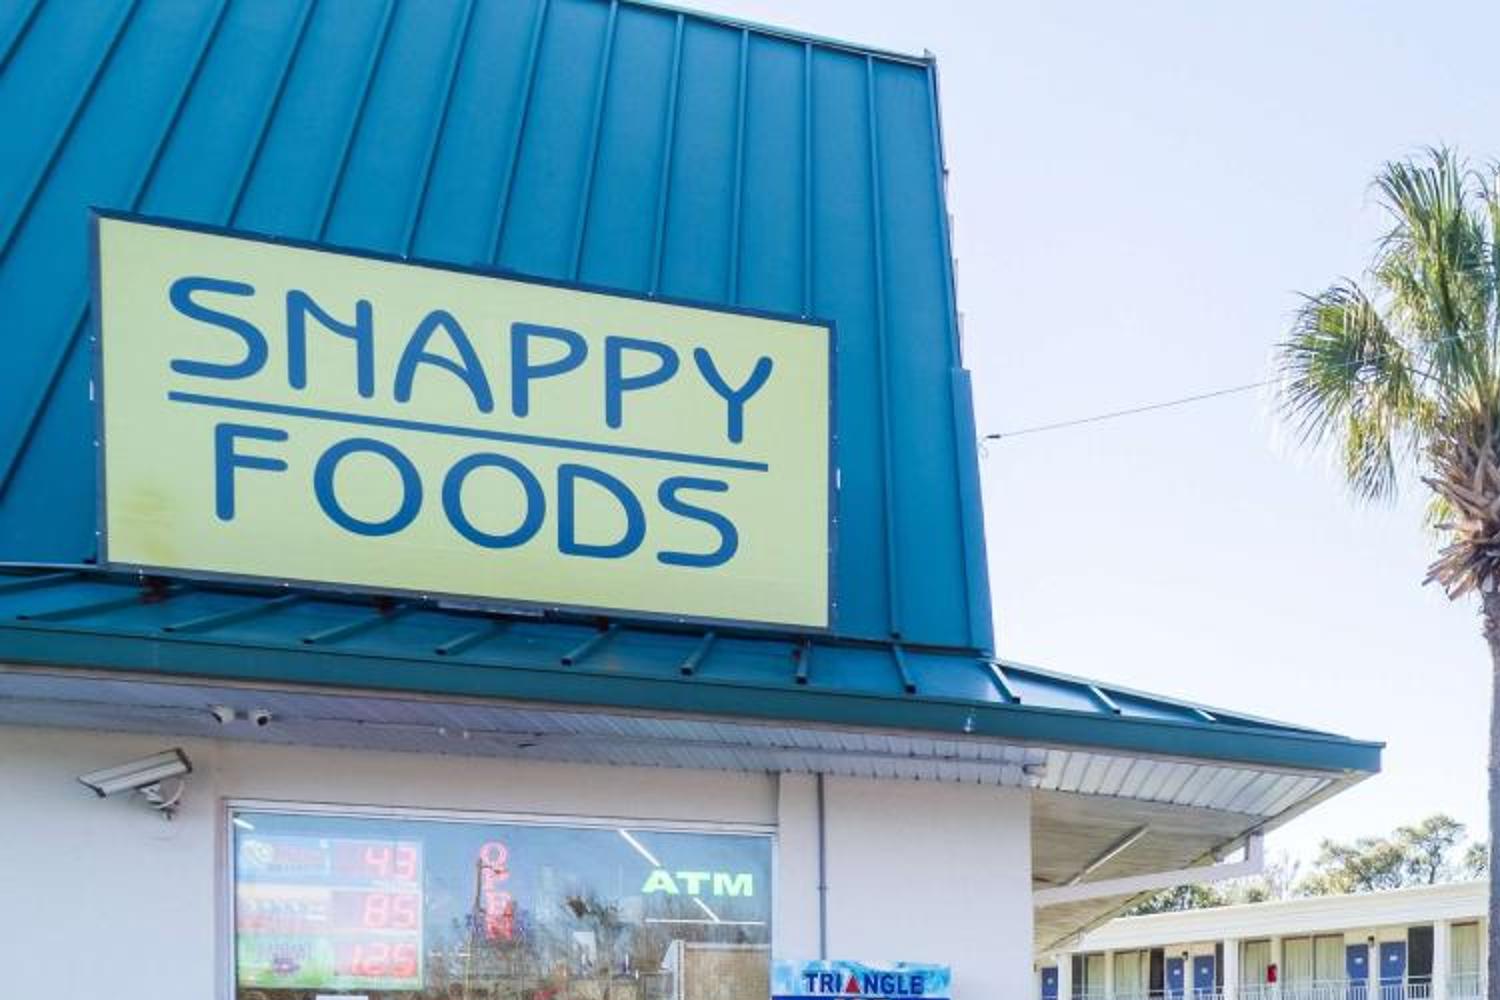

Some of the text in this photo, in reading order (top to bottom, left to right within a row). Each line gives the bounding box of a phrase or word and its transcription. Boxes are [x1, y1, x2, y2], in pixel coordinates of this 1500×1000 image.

[168, 276, 774, 444] SNAPPY
[214, 423, 739, 568] FOODS
[642, 869, 753, 897] ATM
[803, 972, 925, 995] TRIANGLE
